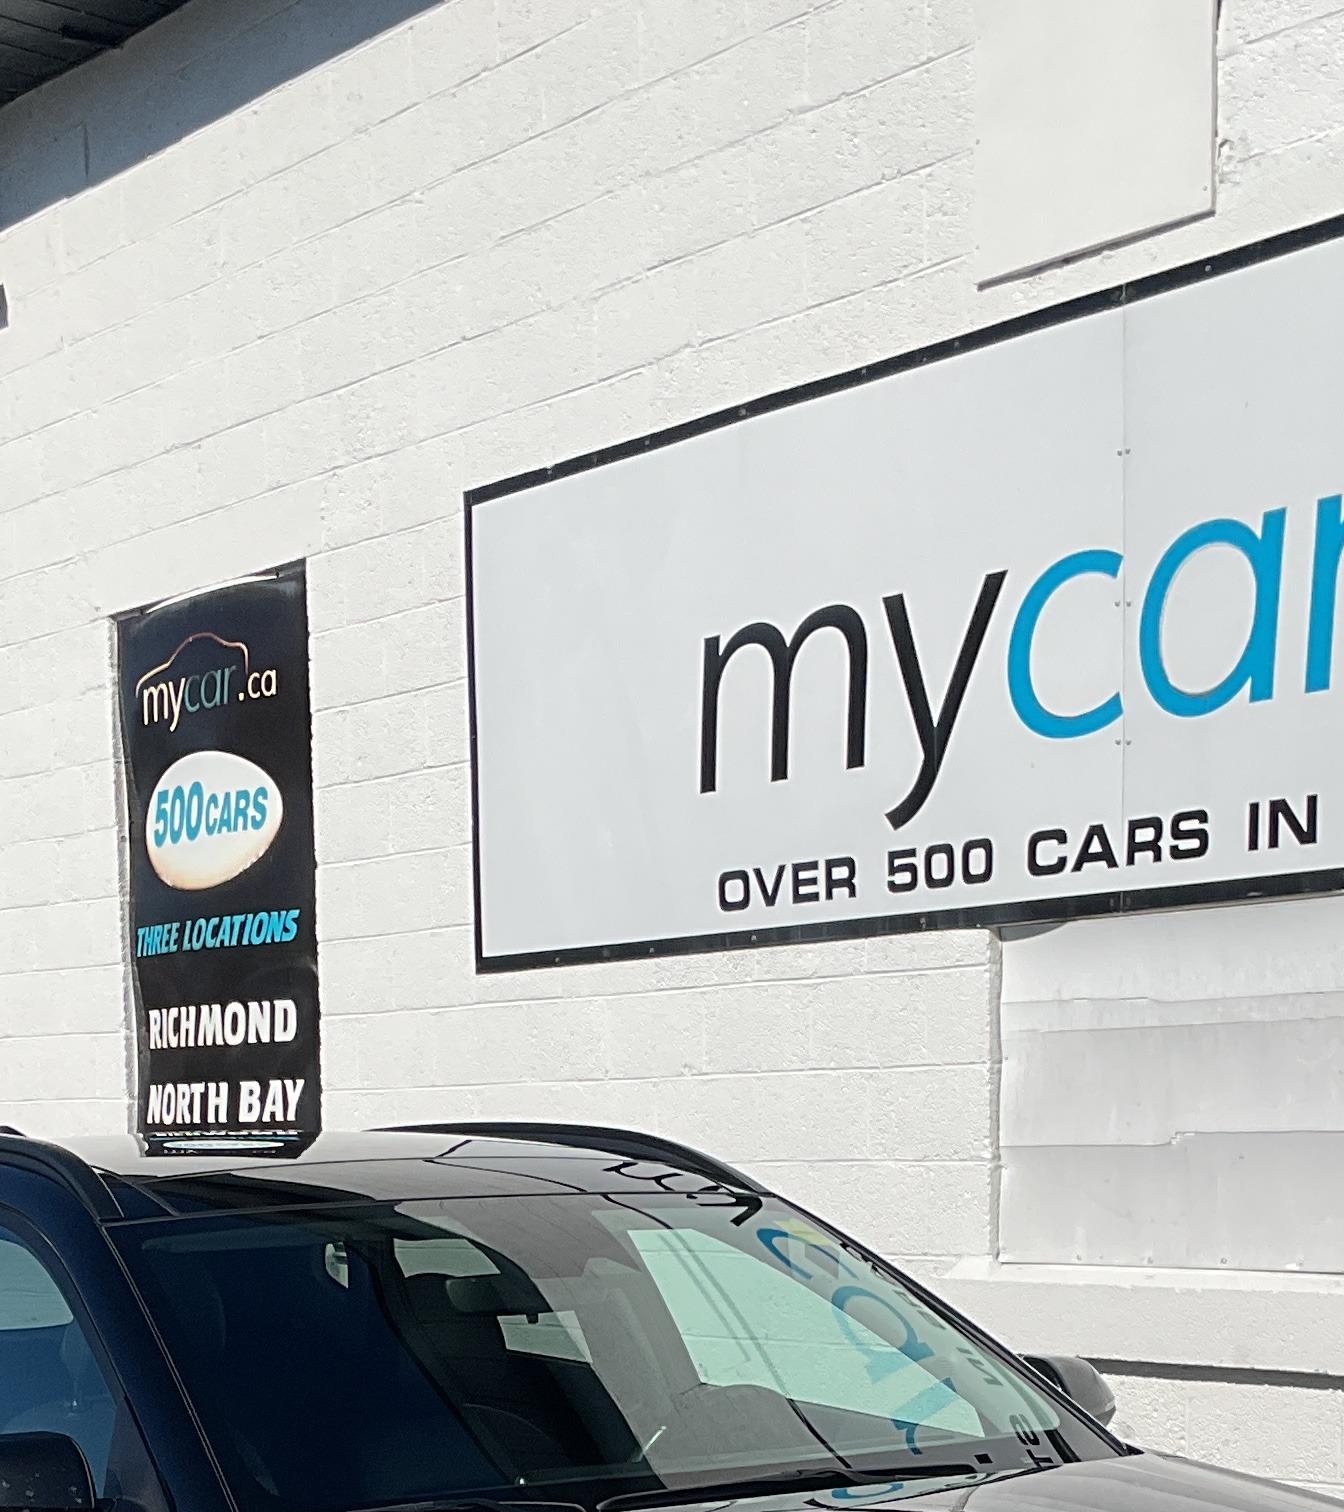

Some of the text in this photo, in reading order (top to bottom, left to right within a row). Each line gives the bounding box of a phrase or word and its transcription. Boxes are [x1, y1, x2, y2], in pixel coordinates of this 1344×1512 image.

[143, 665, 277, 732] mycar.ca
[718, 856, 858, 912] OVER
[887, 838, 993, 894] 500
[1027, 809, 1209, 877] CARS
[1248, 794, 1318, 852] IN
[136, 908, 301, 958] THREE LOCATIONS
[148, 999, 298, 1050] RICHMOND
[146, 1078, 306, 1126] NORTH BAY
